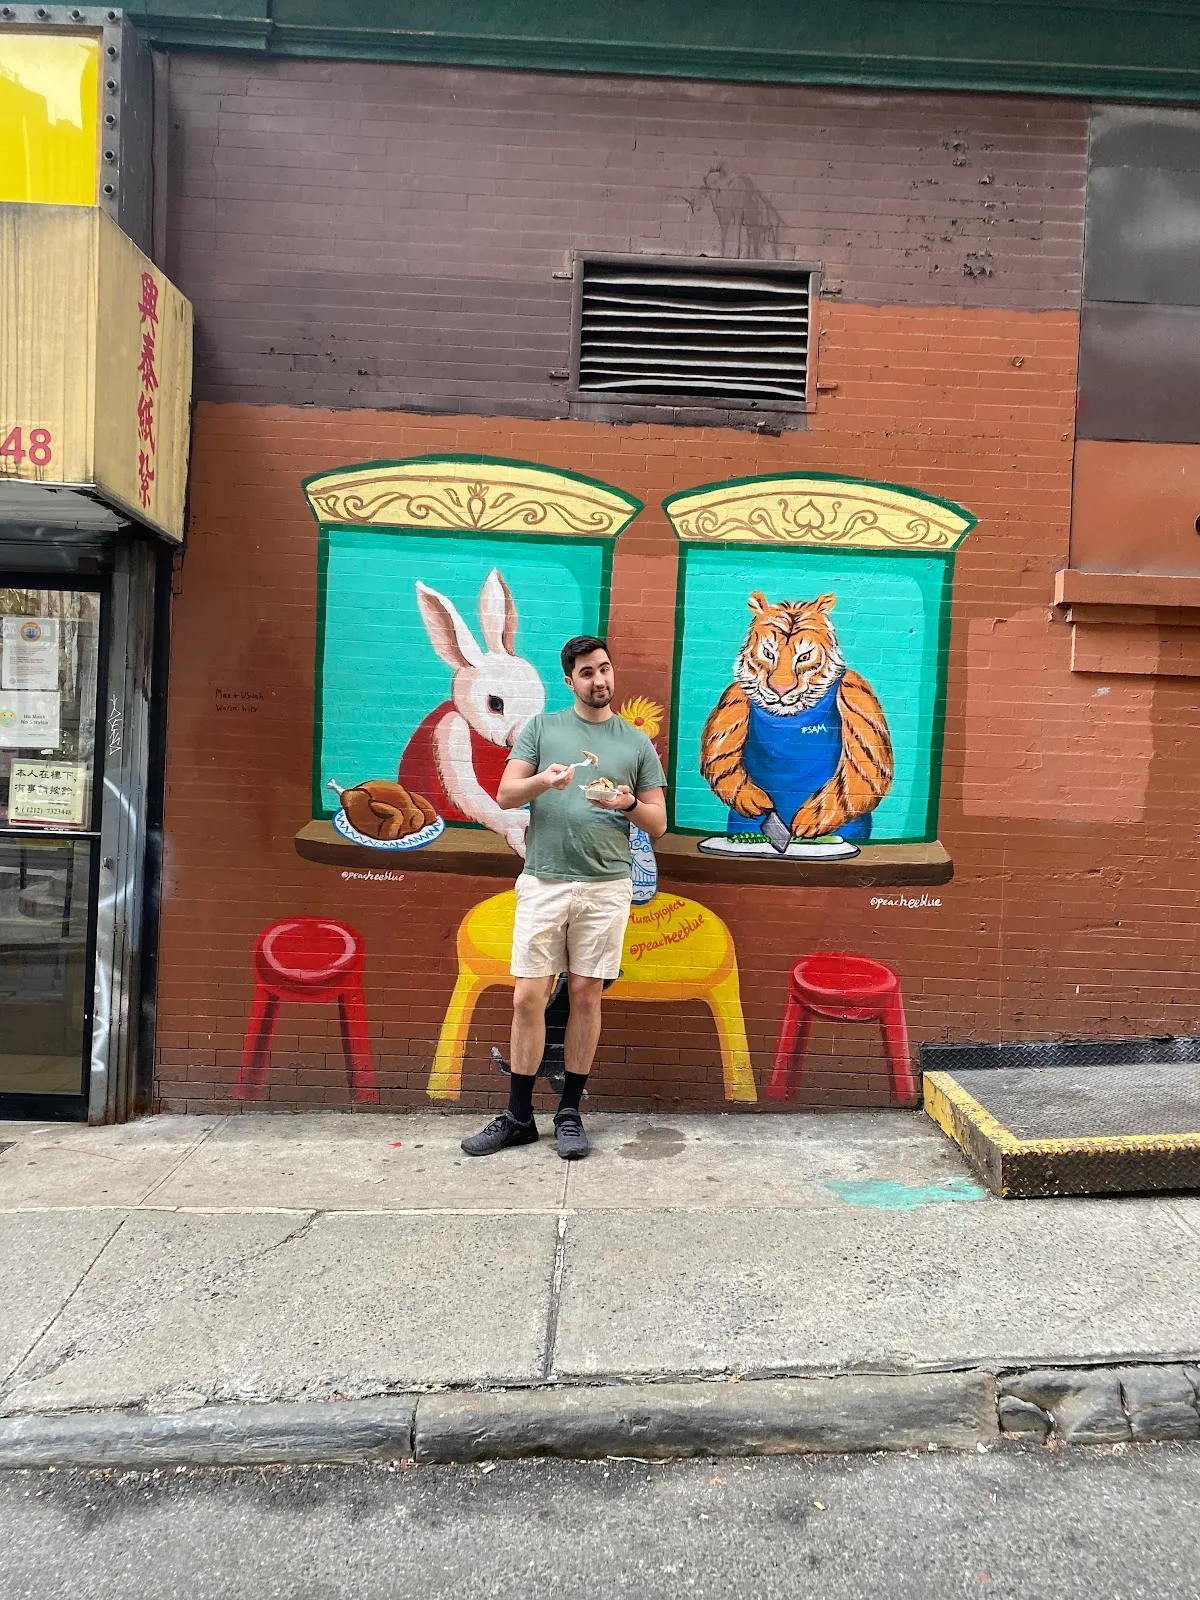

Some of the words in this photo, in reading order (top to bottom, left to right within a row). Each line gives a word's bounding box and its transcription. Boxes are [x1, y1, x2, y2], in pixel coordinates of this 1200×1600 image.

[801, 723, 828, 735] #SAM
[341, 870, 405, 882] @peacheeblue
[870, 892, 943, 910] @peacheeblue
[629, 913, 705, 961] @peacheeblue
